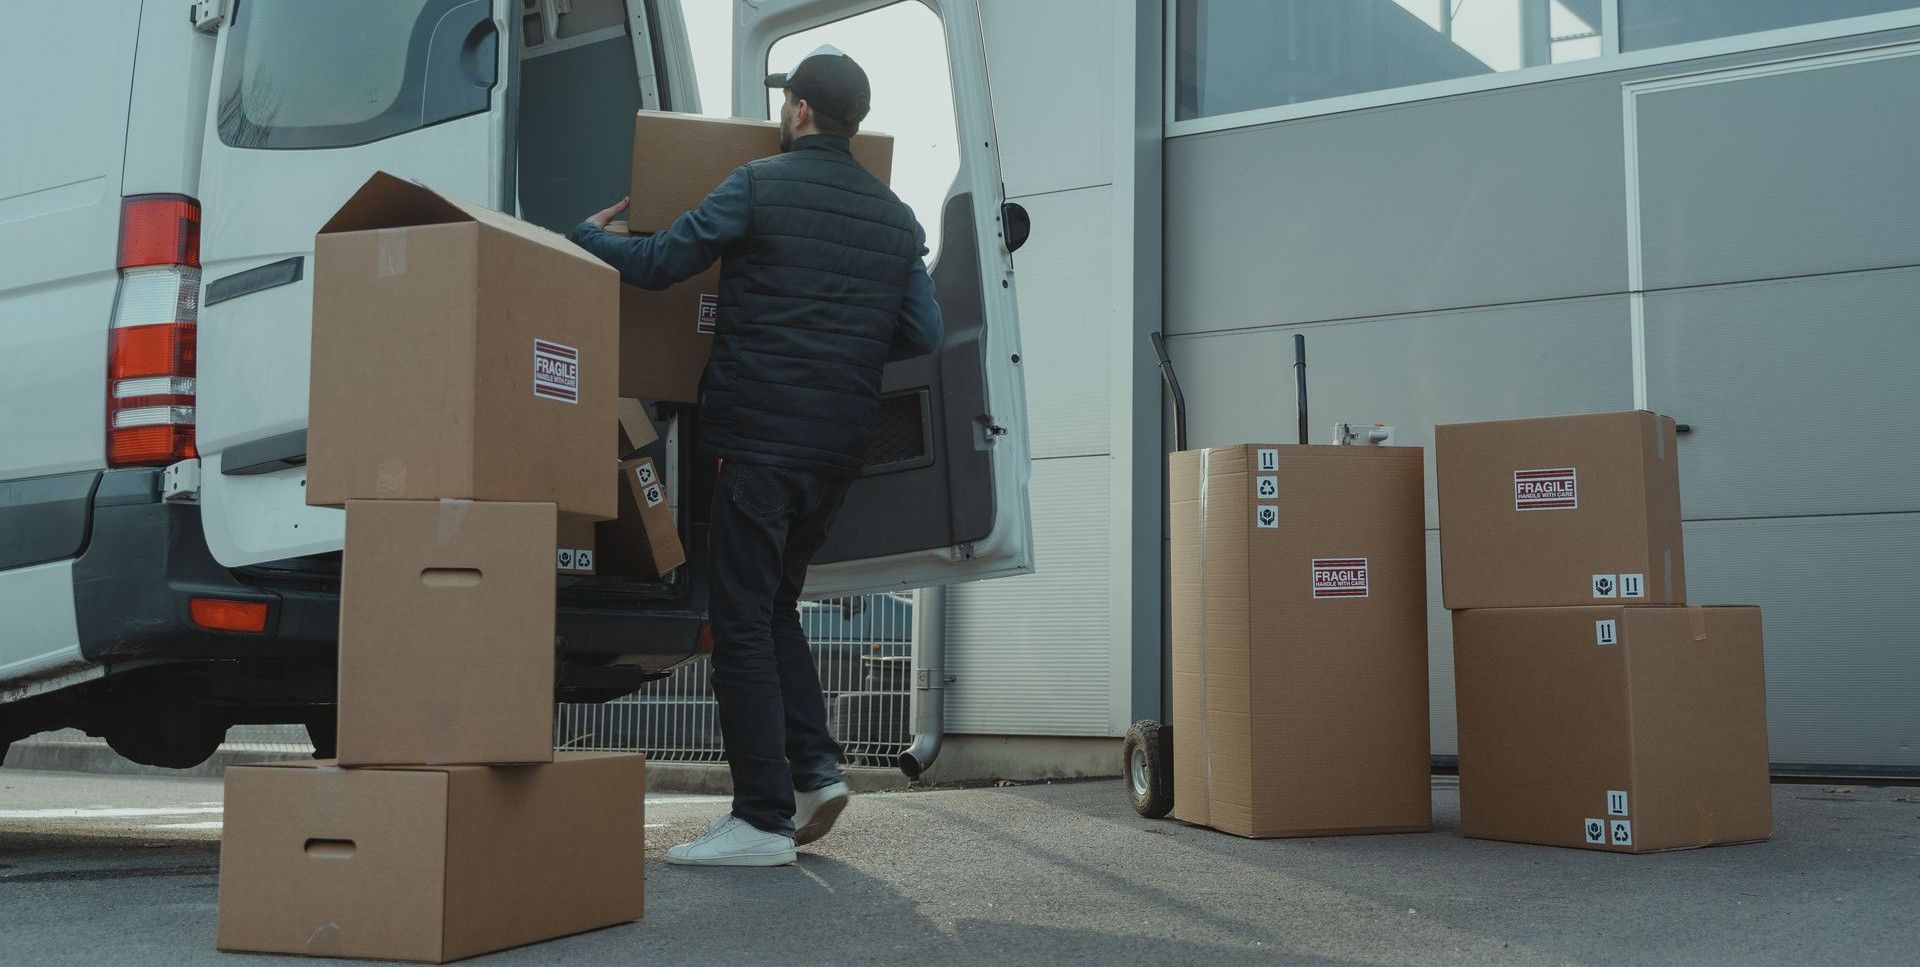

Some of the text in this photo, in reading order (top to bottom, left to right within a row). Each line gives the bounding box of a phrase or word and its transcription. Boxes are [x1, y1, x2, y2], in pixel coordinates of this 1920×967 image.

[537, 357, 576, 380] FRAGILE
[1517, 481, 1573, 494] FRAGILE
[1315, 570, 1365, 582] FRAGILE
